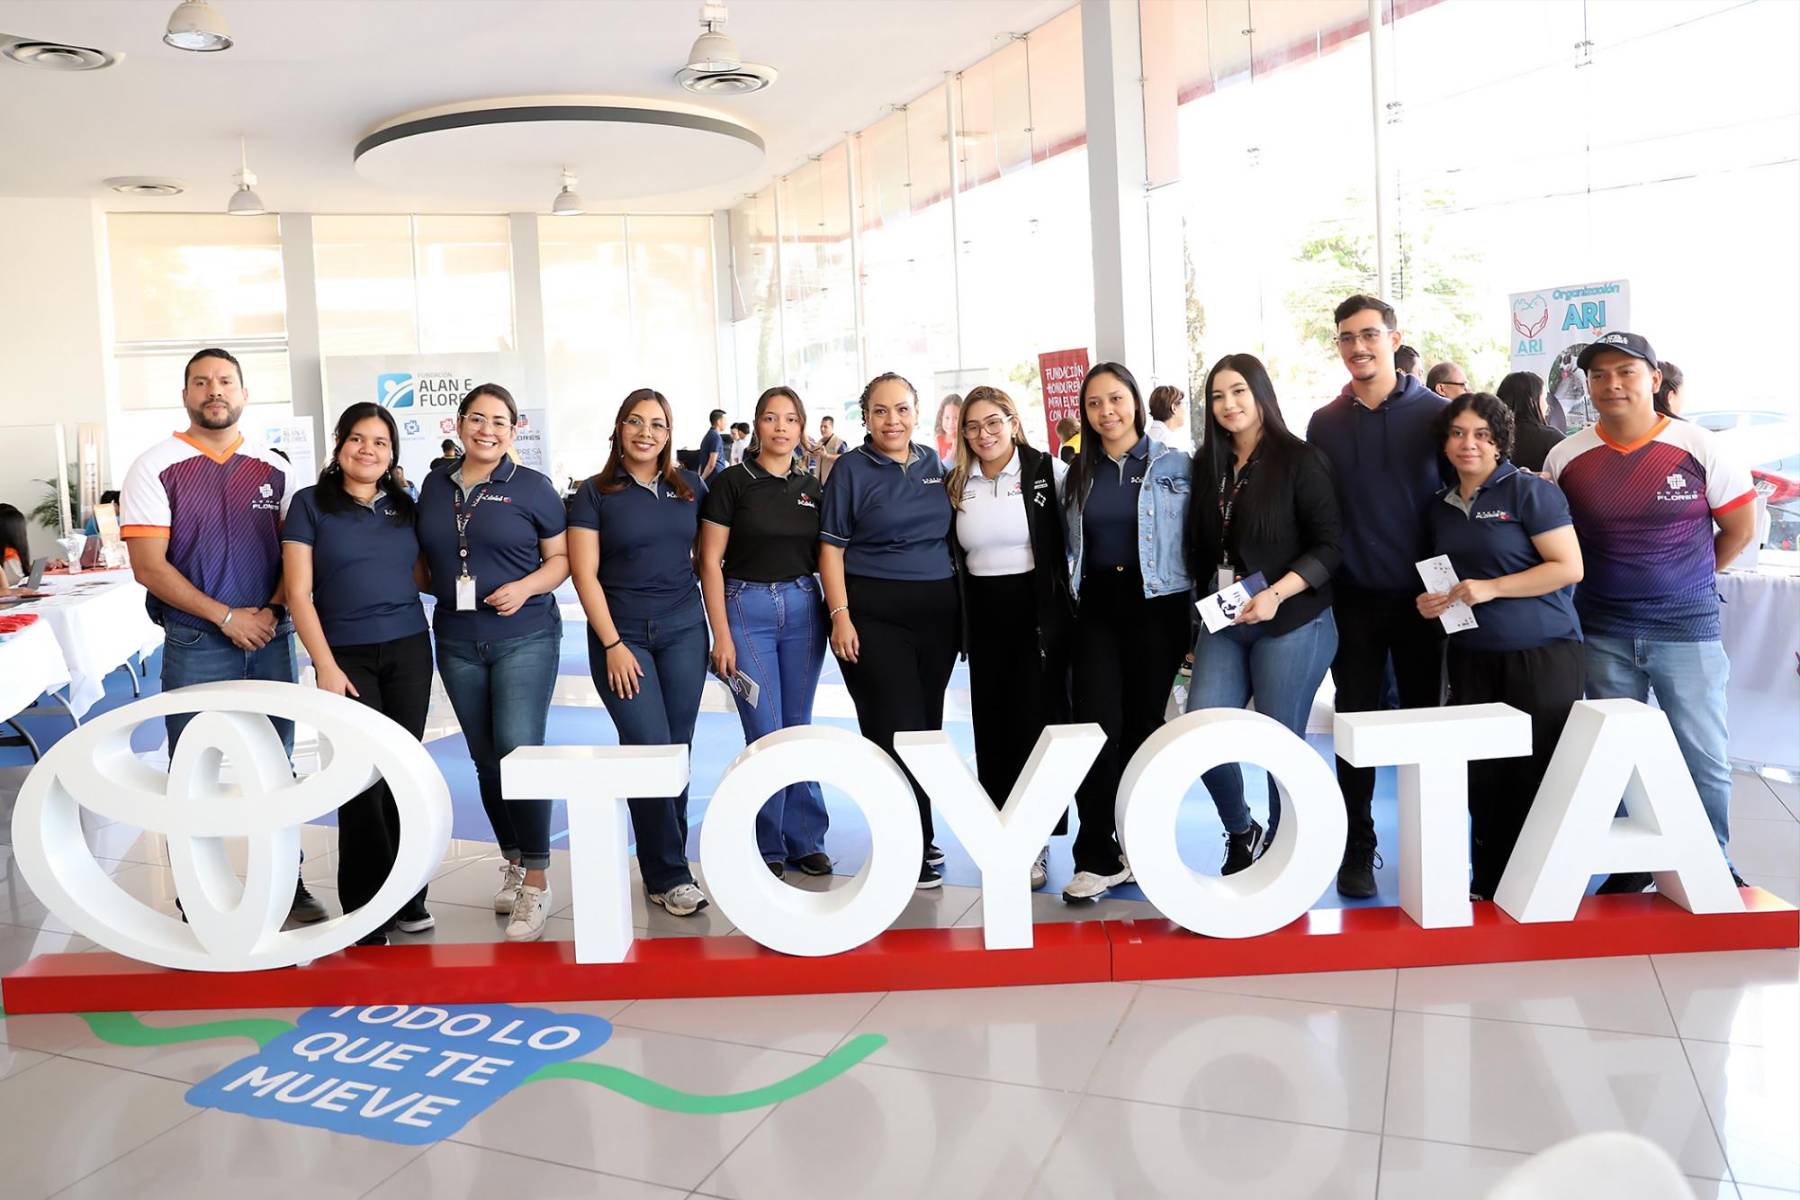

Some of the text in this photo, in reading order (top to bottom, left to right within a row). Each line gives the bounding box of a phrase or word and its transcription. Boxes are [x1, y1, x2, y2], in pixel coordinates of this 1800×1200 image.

[1552, 283, 1620, 301] Organización
[1561, 300, 1606, 331] ARI
[1517, 339, 1543, 353] ARI
[419, 379, 459, 392] ALAN
[501, 698, 1747, 964] TOYOTA
[488, 1019, 581, 1050] LO
[292, 1032, 514, 1086] QUE TE
[221, 1065, 460, 1128] MUEVE
